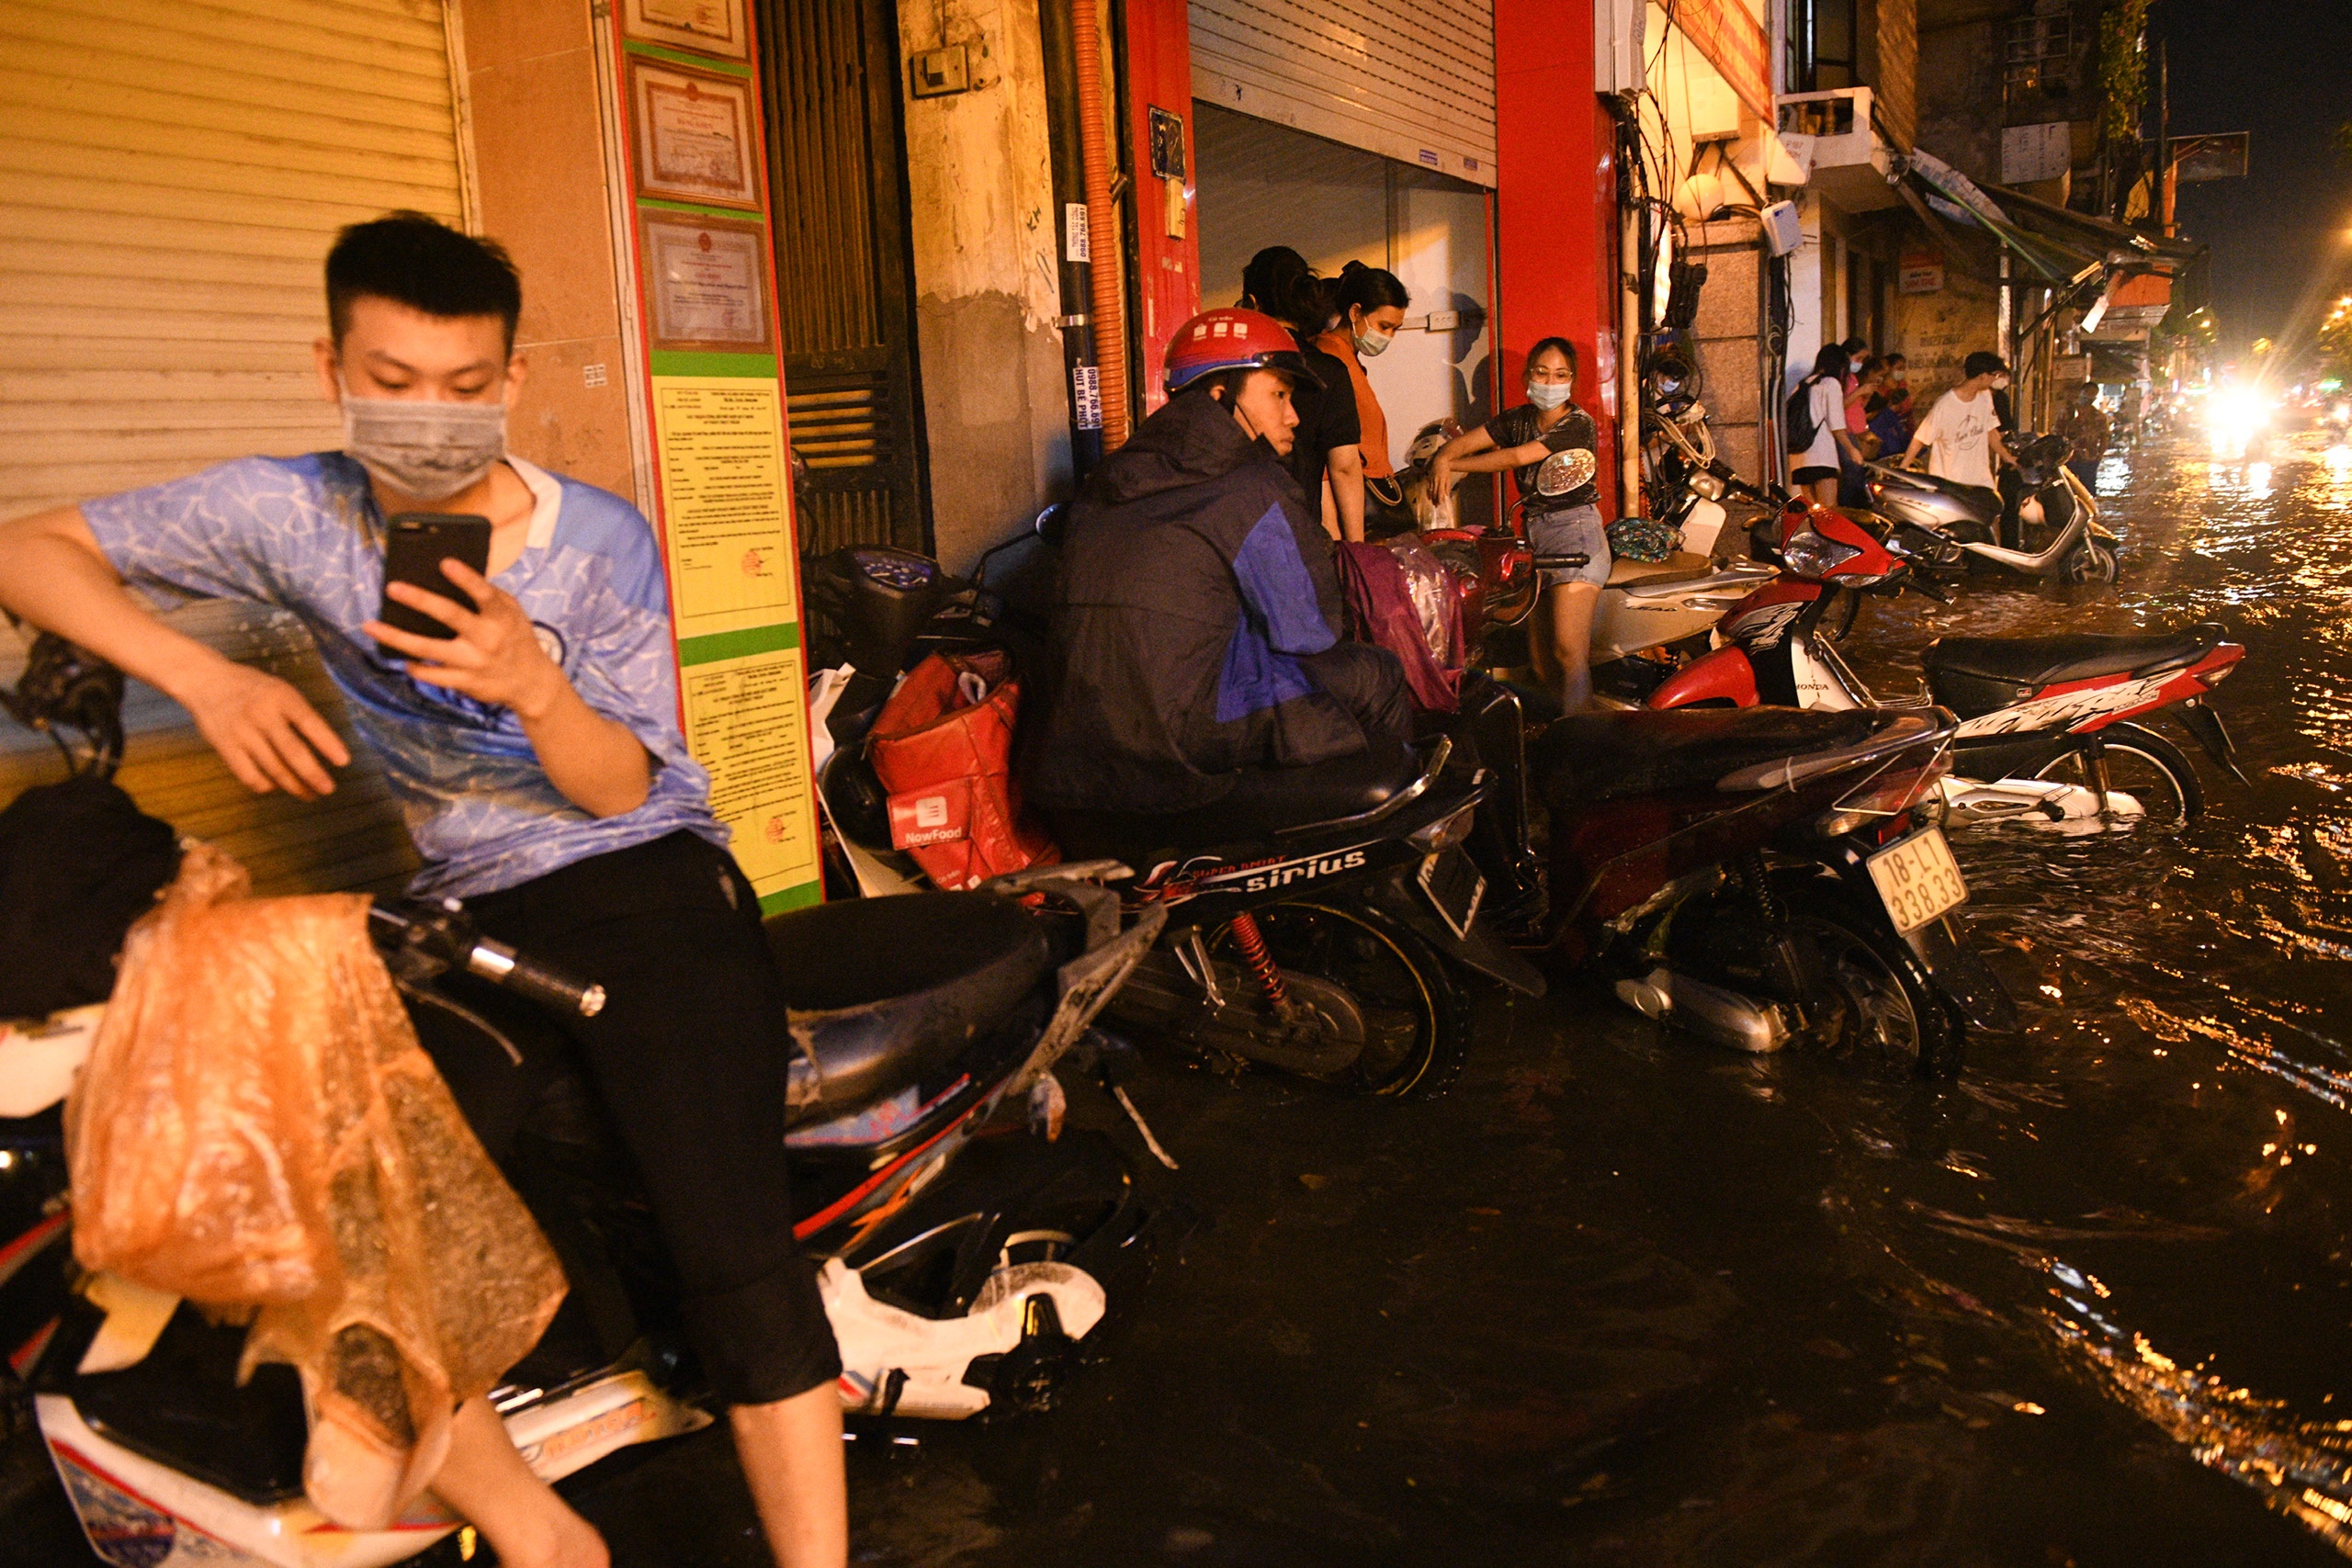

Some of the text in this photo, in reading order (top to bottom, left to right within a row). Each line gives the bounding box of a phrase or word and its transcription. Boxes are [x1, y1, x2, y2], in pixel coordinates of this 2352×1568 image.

[905, 827, 963, 844] NowFood
[1883, 837, 1941, 888] 18-L1
[1893, 867, 1962, 928] 338.33
